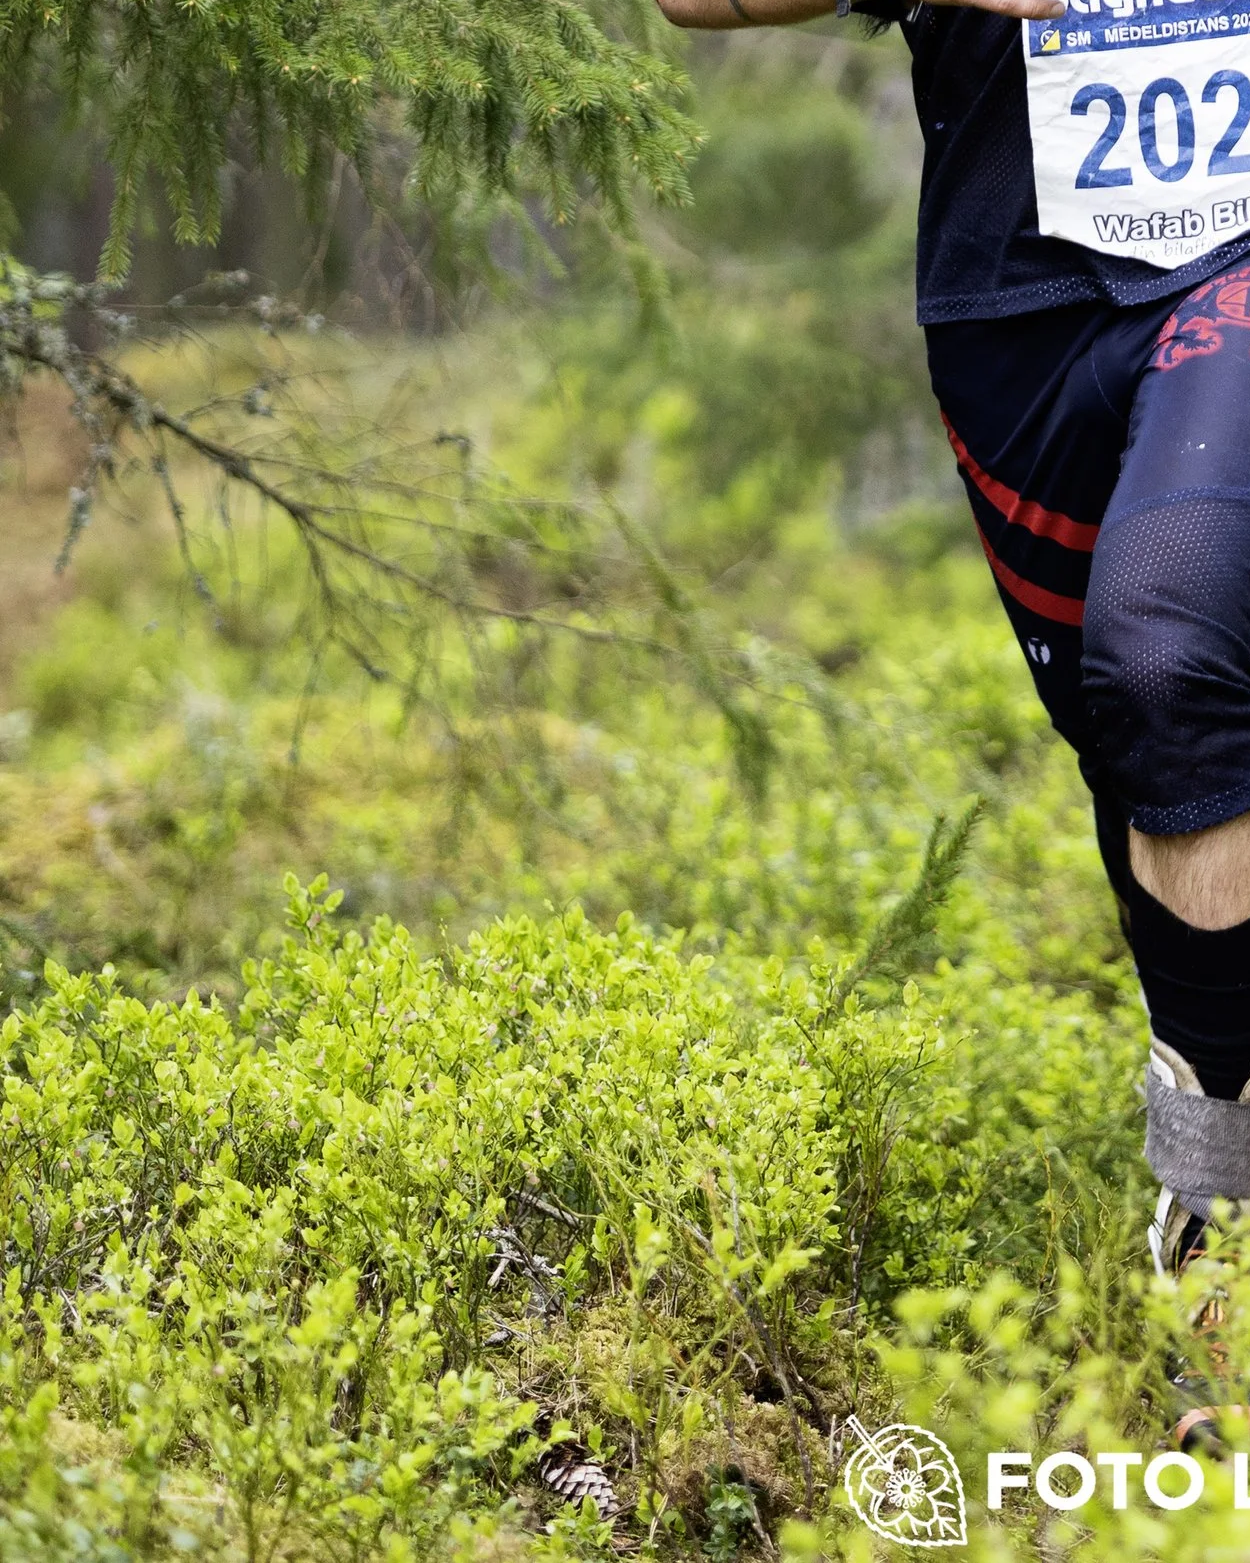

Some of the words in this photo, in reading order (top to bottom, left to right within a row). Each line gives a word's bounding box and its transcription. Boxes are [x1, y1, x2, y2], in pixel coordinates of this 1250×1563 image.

[1066, 30, 1091, 47] SM
[1104, 16, 1229, 43] MEDELDISTANS
[1093, 209, 1205, 242] Wafab
